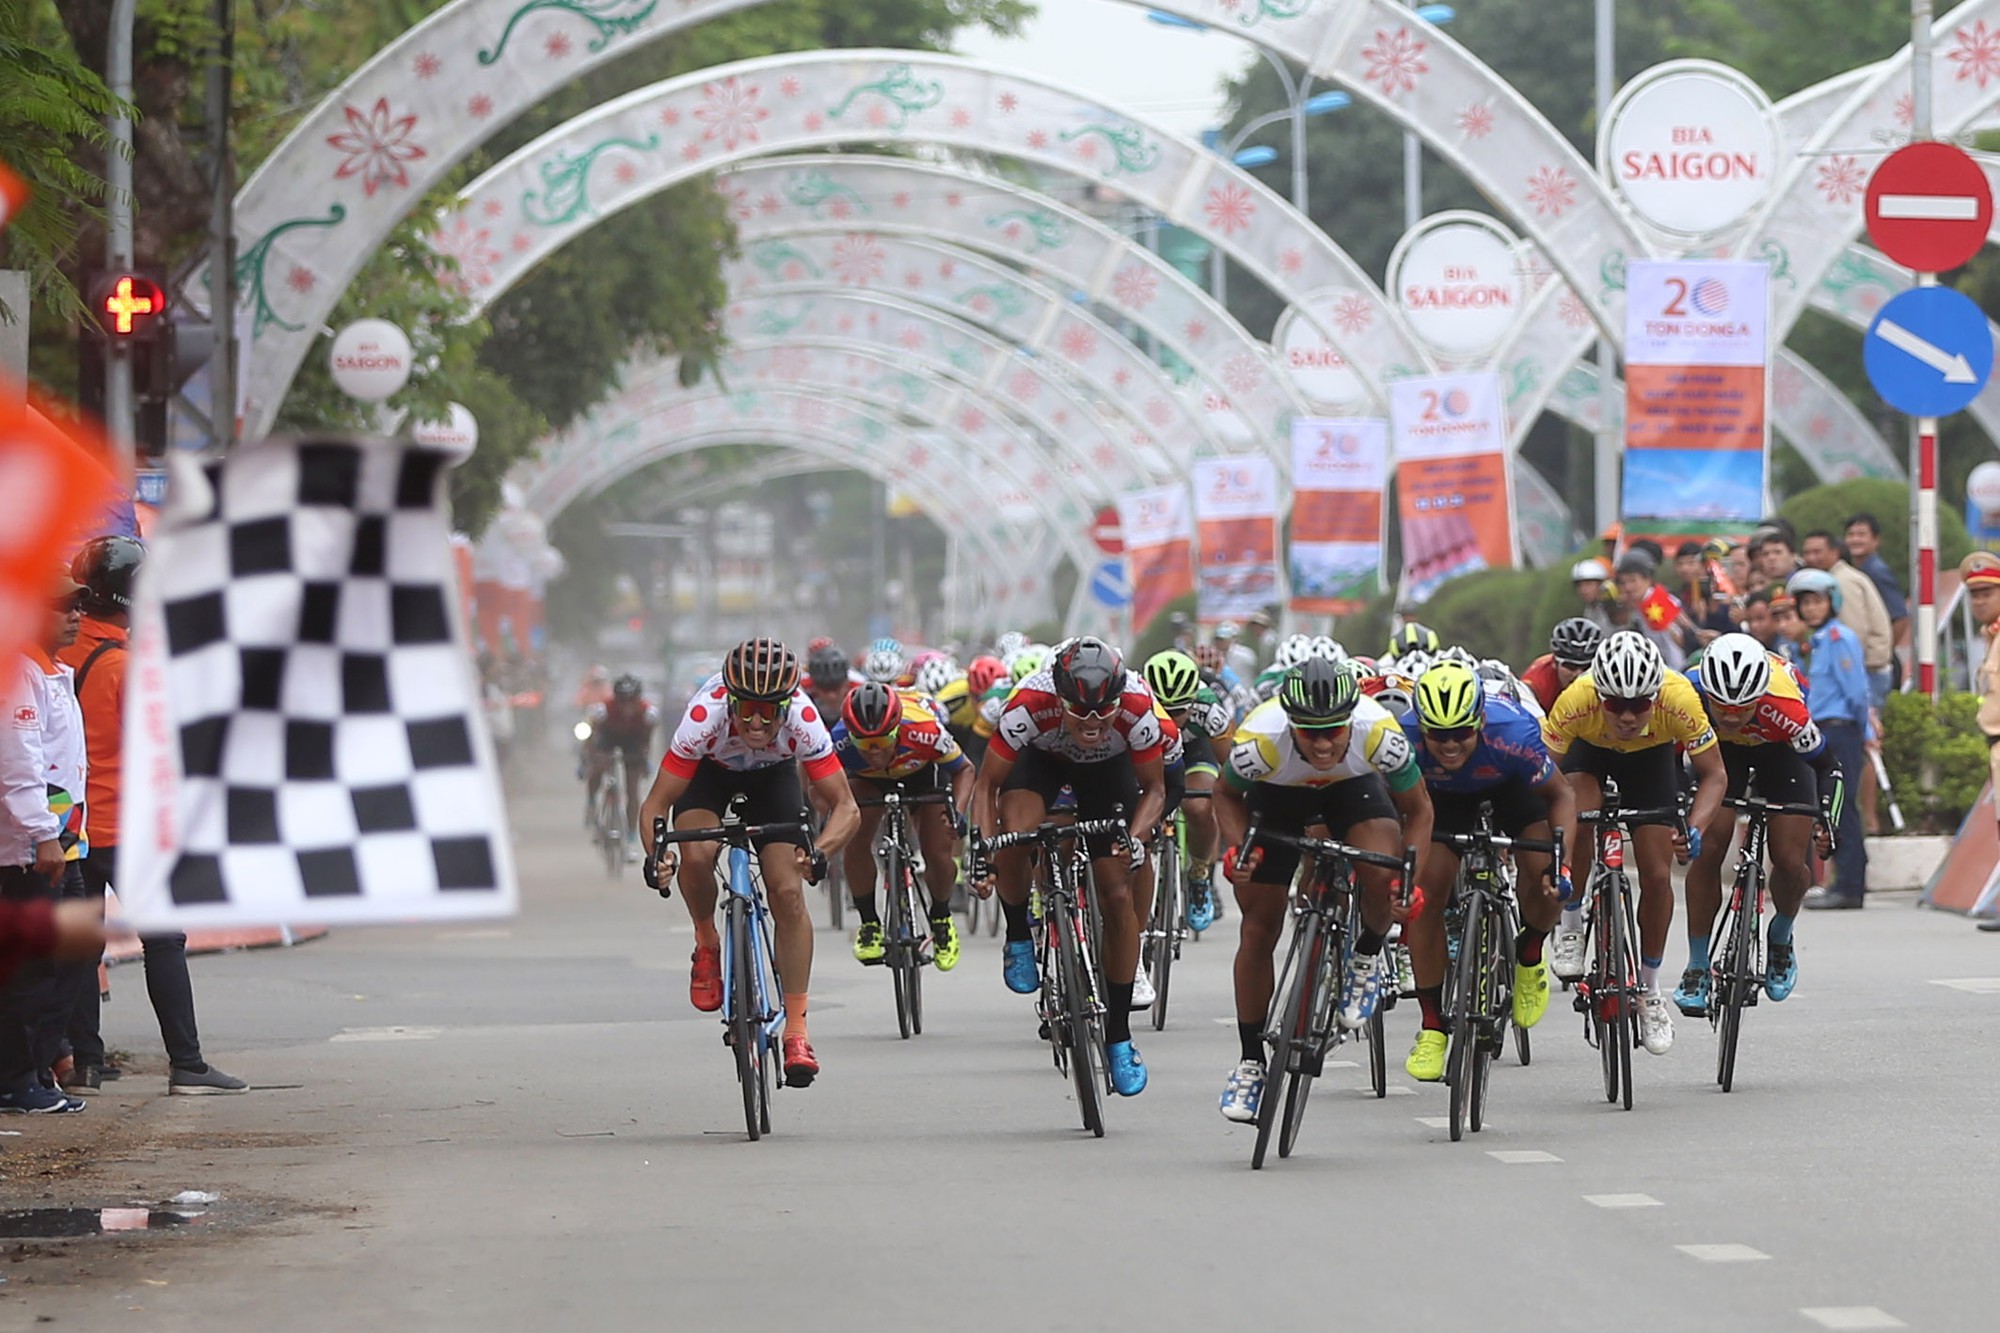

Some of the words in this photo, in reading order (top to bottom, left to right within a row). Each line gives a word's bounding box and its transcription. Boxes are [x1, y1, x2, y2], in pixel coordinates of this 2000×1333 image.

[1671, 126, 1713, 144] BIA
[1622, 151, 1757, 180] SAIGON
[1407, 285, 1511, 308] SAIGON
[1290, 351, 1345, 367] SAIG
[1007, 722, 1028, 738] 2
[1140, 726, 1153, 743] 2
[1380, 736, 1405, 768] 113
